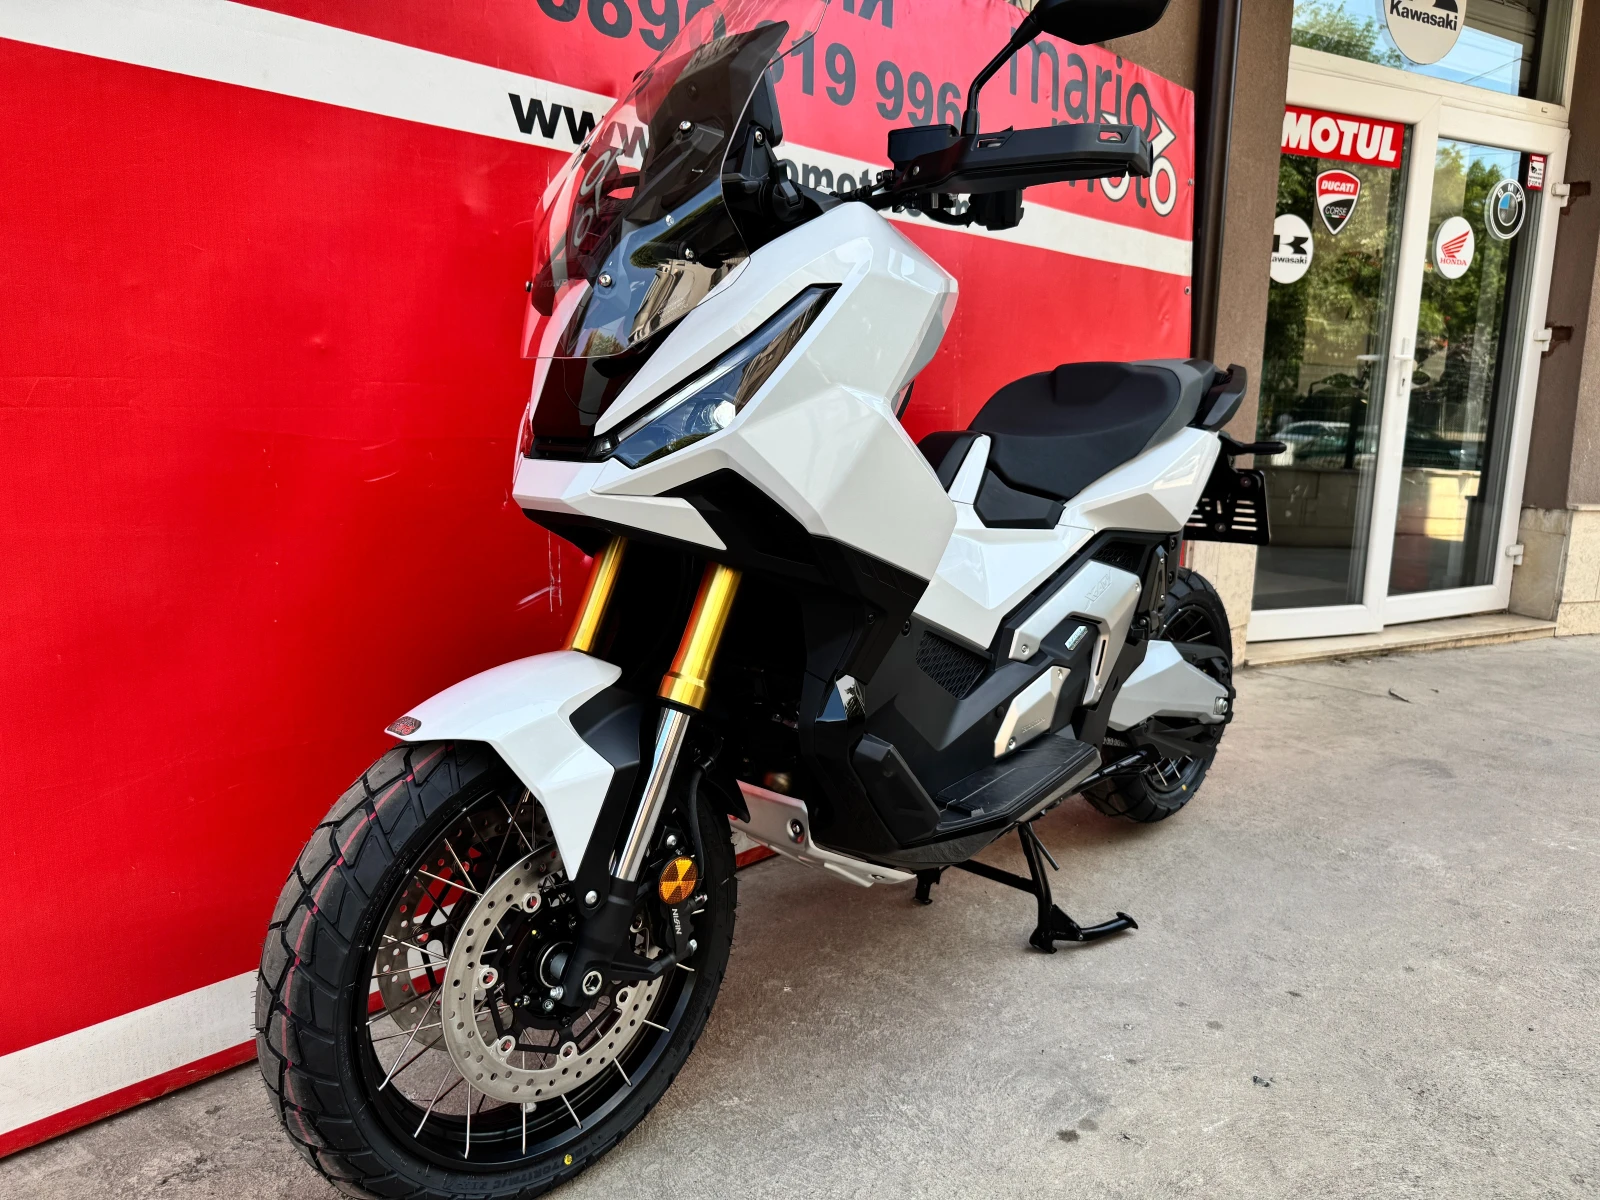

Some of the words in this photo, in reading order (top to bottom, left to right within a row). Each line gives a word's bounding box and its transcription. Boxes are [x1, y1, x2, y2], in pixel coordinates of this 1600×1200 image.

[1390, 0, 1458, 31] Kawasaki
[1009, 26, 1153, 139] mario
[876, 60, 962, 134] 996
[1281, 111, 1397, 162] MOTUL
[1321, 179, 1355, 193] DUCATI
[1497, 183, 1523, 203] BMW
[1324, 205, 1347, 216] CORSE
[1271, 255, 1307, 265] awasaki
[1440, 257, 1468, 267] HONDA
